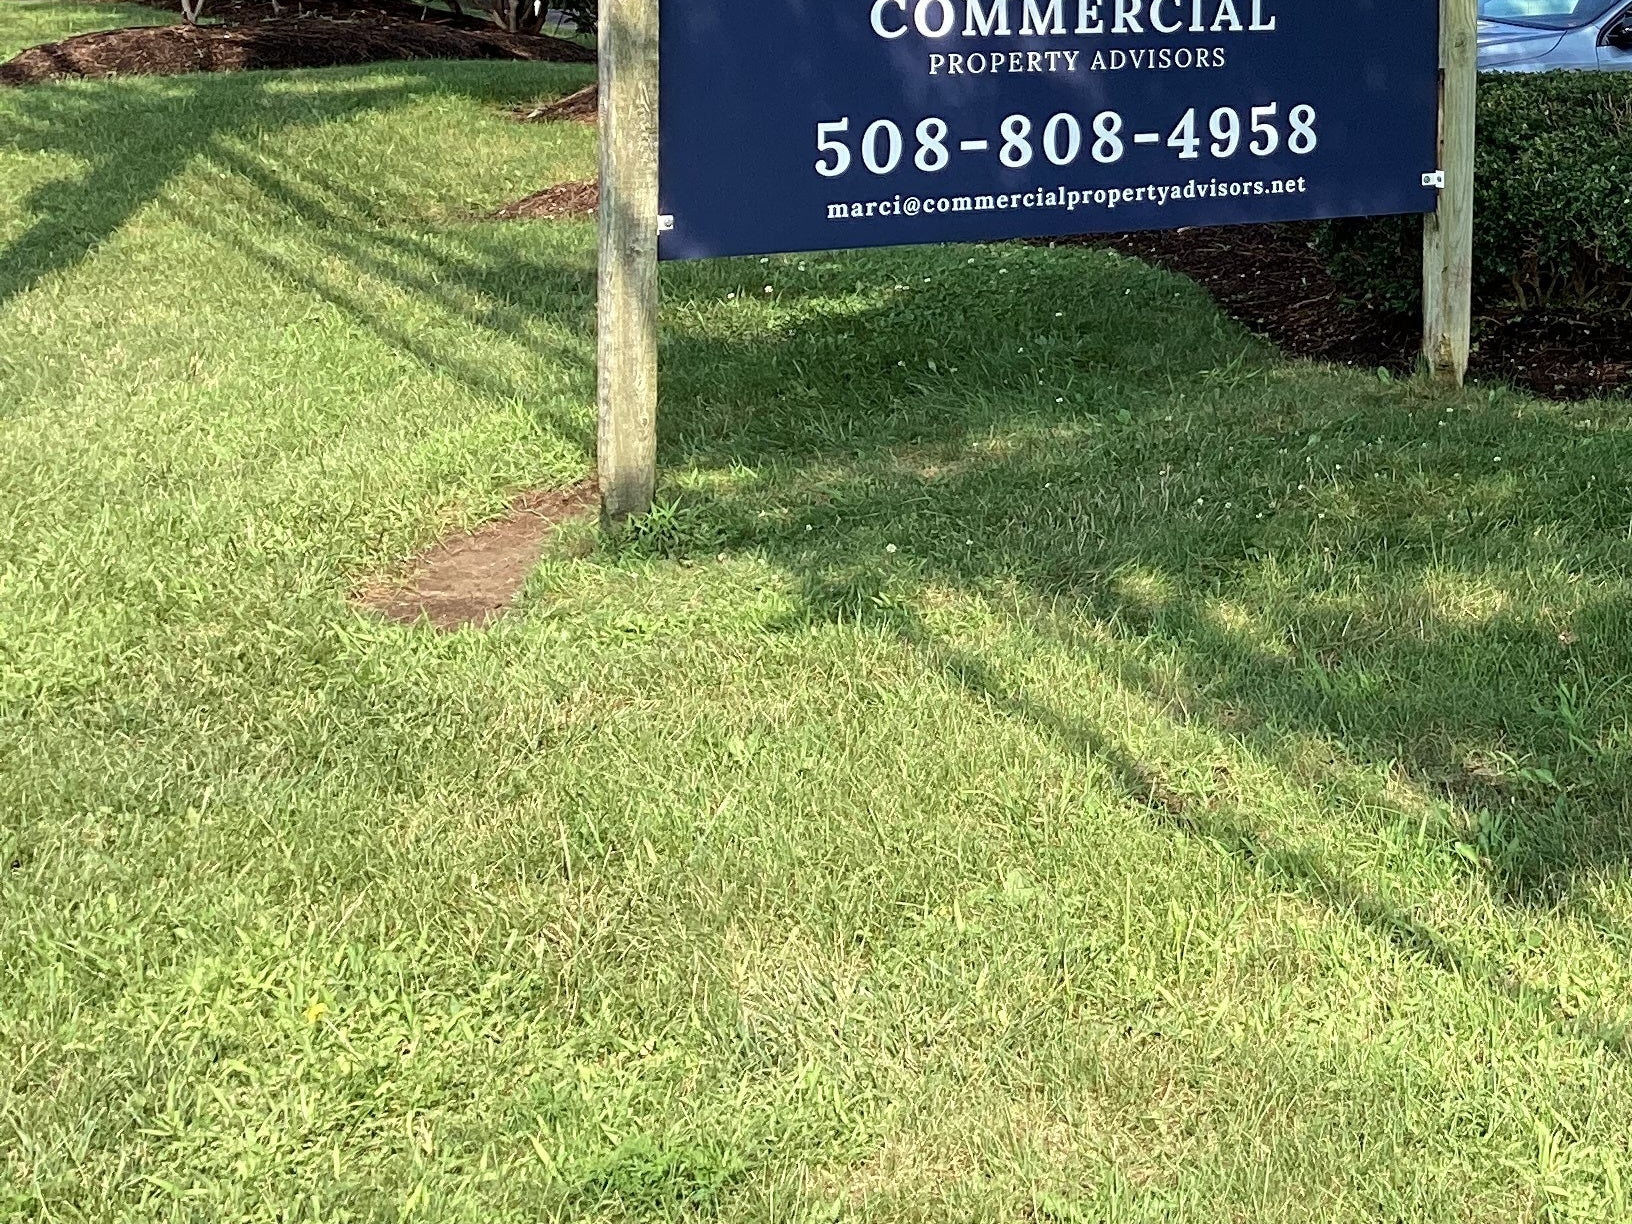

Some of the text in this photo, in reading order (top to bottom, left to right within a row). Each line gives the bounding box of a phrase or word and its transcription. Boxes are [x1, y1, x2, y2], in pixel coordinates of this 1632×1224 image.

[928, 46, 1226, 76] PROPERTY ADVISORS
[815, 102, 1318, 177] 508-808-4958
[826, 176, 1308, 219] marci@commercialpropertyadvisors.net
